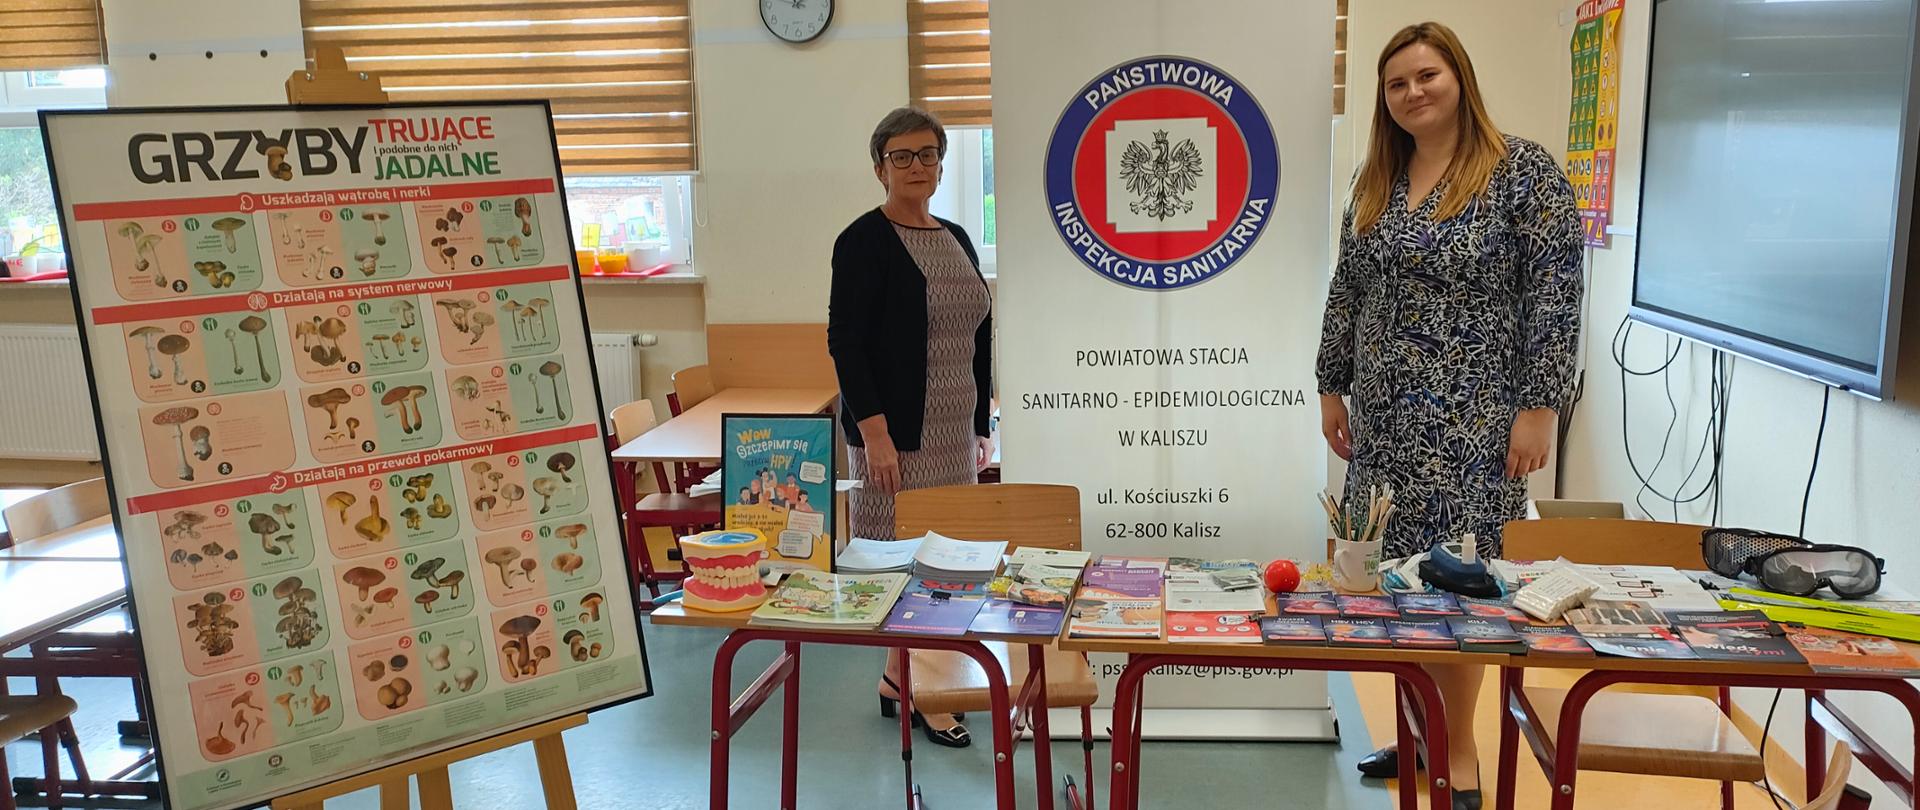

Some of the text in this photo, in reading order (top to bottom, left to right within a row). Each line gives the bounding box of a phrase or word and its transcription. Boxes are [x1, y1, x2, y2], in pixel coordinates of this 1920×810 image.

[771, 14, 777, 25] 8
[818, 12, 824, 22] 4
[783, 24, 789, 35] 7
[795, 27, 802, 38] 6
[808, 23, 815, 33] 5
[1085, 62, 1235, 111] PAŃSTWOWA
[368, 116, 495, 146] TRUJĄCE
[128, 126, 369, 184] GRZYBY
[379, 144, 421, 157] podobne
[423, 143, 435, 153] do
[437, 142, 458, 152] nich
[374, 151, 502, 180] JADALNE
[262, 191, 335, 206] Uszkadzają
[338, 187, 391, 204] wątrobę
[400, 186, 431, 198] nerki
[1055, 197, 1269, 285] INSPEKCJA SANITARNA
[274, 279, 453, 304] Działają na system nerwowy
[1076, 347, 1249, 367] POWIATOWA STACJA
[1022, 391, 1119, 410] SANITARNO
[1134, 389, 1306, 408] EPIDEMIOLOGICZNA
[1118, 429, 1208, 447] W KALISZU
[294, 442, 494, 484] Działają na przewód pokarmowy
[1097, 486, 1230, 505] ul. Kościuszki 6
[1105, 521, 1221, 539] 62-800 Kalisz
